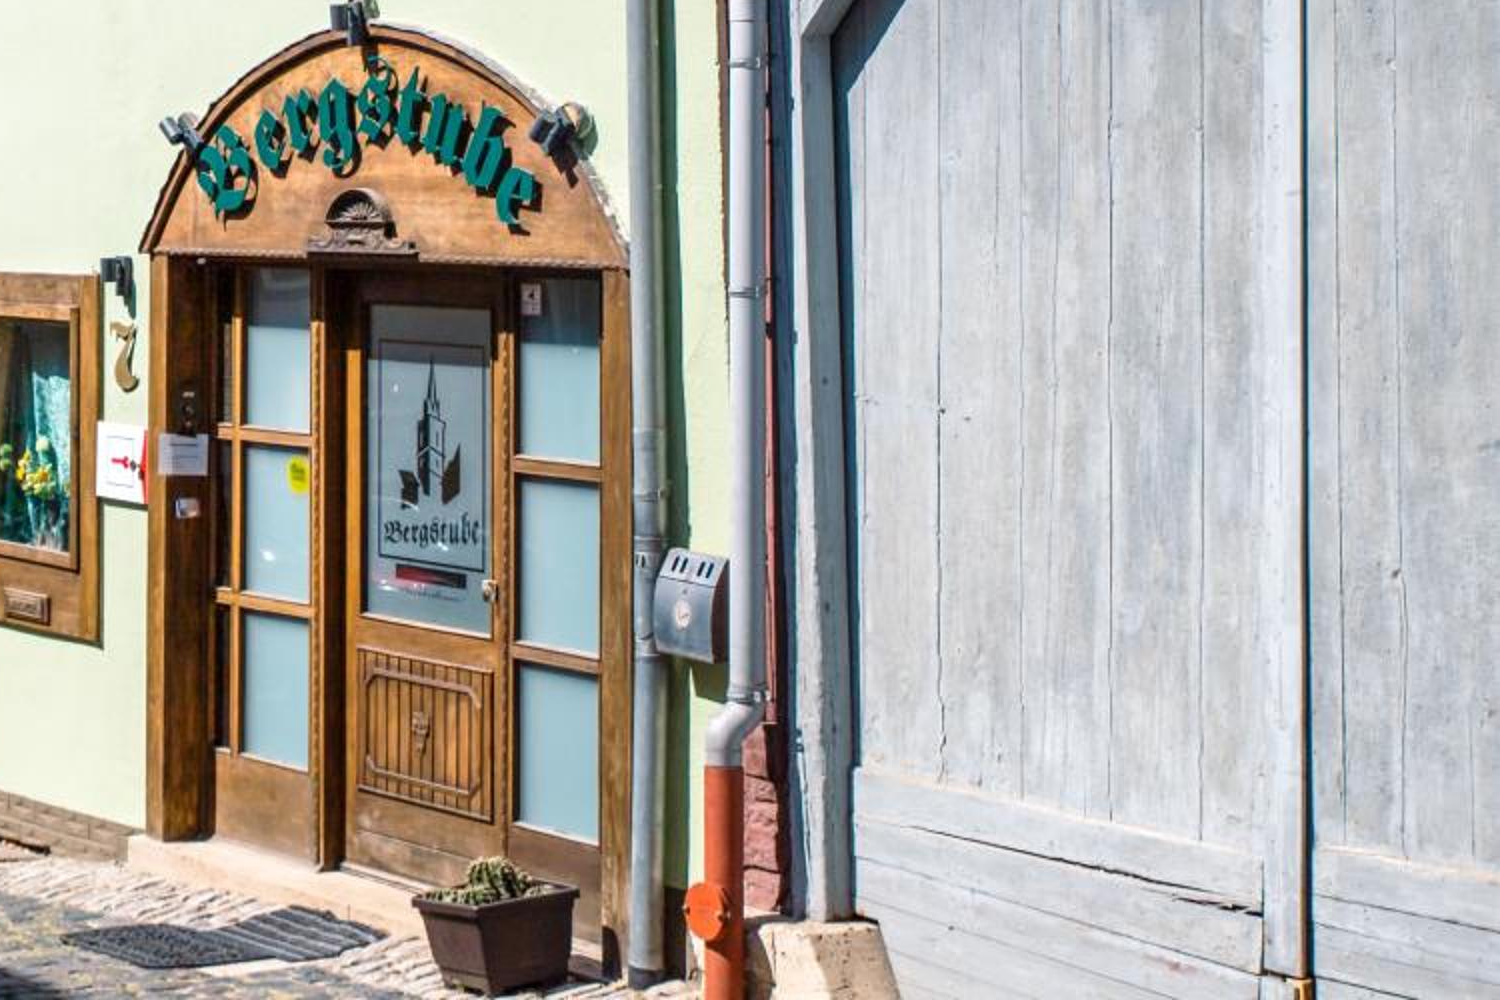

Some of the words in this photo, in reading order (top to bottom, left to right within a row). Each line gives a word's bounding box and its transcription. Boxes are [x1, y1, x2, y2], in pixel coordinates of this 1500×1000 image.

[196, 55, 536, 224] Bergstube
[110, 321, 138, 391] 7
[384, 512, 479, 548] Bergstube
